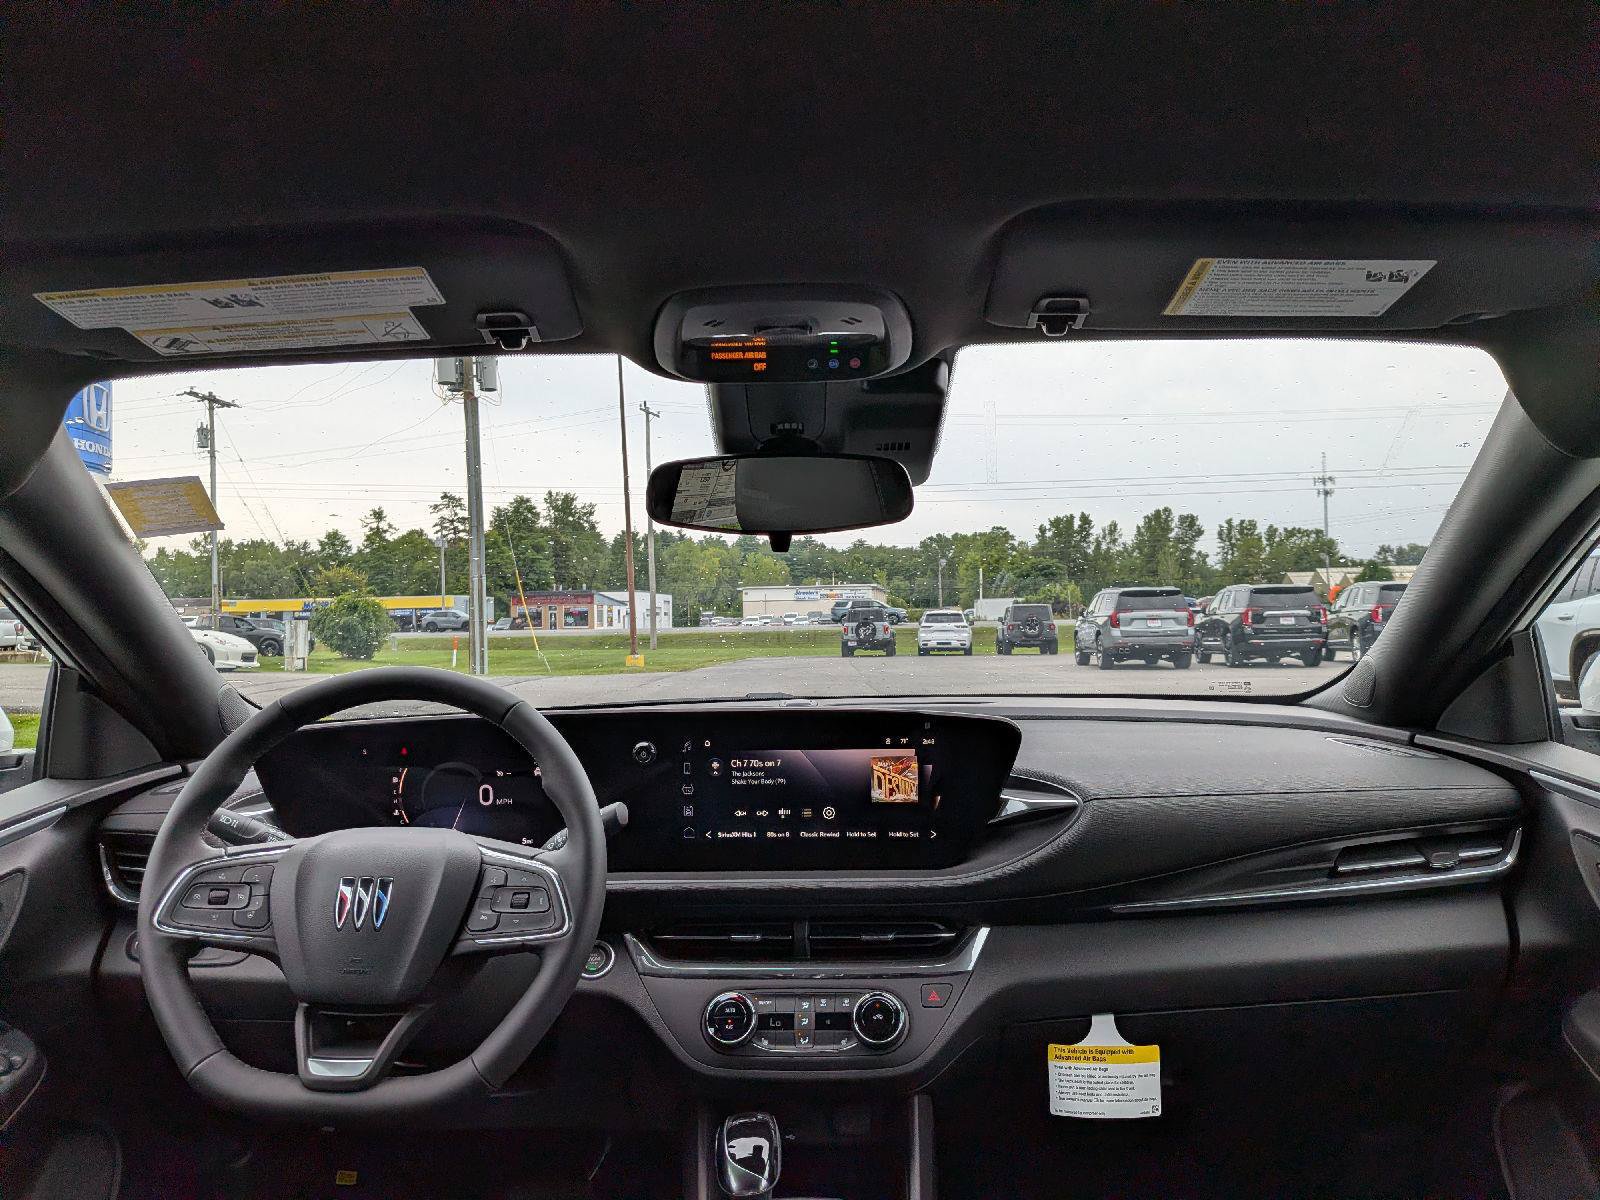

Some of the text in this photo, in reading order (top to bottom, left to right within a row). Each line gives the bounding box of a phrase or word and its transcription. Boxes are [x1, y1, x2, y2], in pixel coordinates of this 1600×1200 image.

[753, 362, 767, 371] OFF
[731, 759, 742, 768] Ch
[743, 759, 749, 767] 7
[750, 759, 764, 768] 70s
[776, 759, 782, 767] 7
[479, 784, 494, 806] 0
